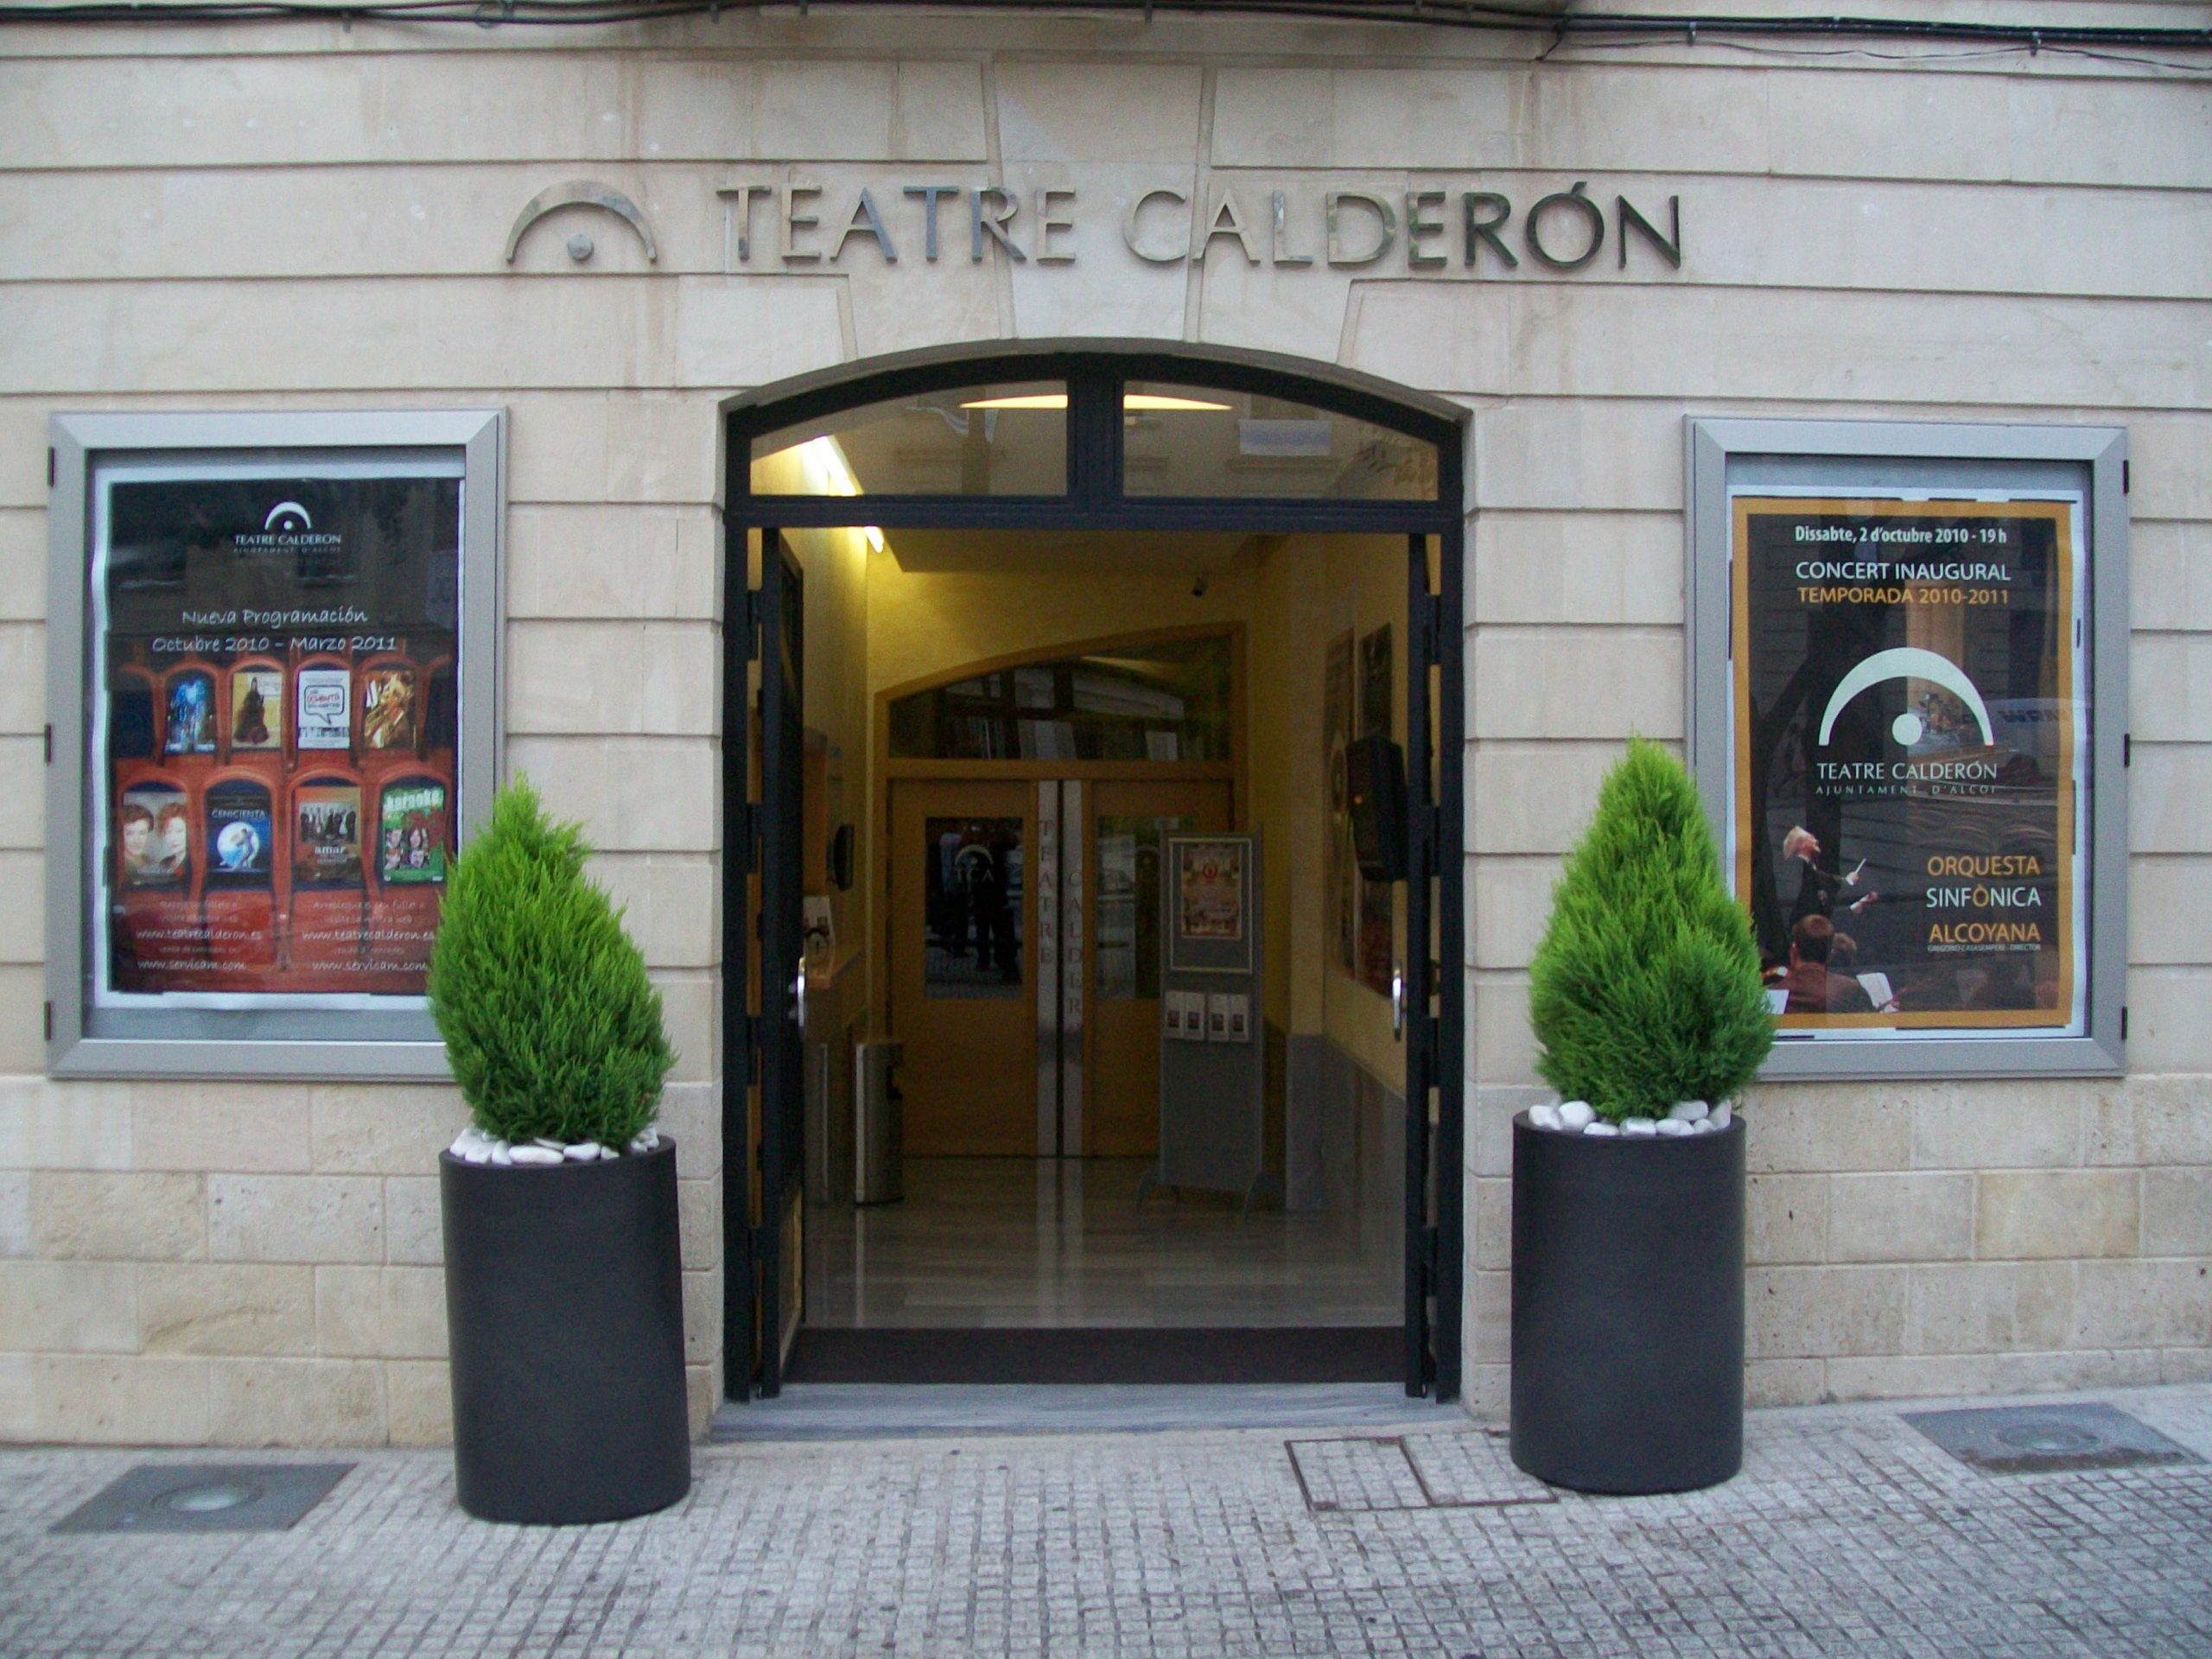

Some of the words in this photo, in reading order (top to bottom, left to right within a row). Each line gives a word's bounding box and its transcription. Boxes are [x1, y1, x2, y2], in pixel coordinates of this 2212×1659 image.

[715, 184, 1076, 263] TEATRE
[1123, 181, 1681, 269] CALDERÓN
[234, 533, 275, 545] TEATRE
[1795, 525, 1857, 543] Dissabte,
[1859, 527, 1868, 542] 2
[1936, 528, 1968, 543] 2010
[1980, 529, 1996, 543] 19
[1998, 529, 2006, 543] h
[1796, 562, 1890, 580] CONCERT
[1895, 563, 2012, 581] INAUGURAL
[1797, 587, 1916, 604] TEMPORADA
[1919, 588, 2009, 605] 2010-2011
[181, 609, 236, 624] Nueva
[242, 606, 368, 629] Programación
[152, 636, 219, 652] Octubre
[225, 637, 270, 651] 2010
[289, 637, 346, 651] Marzo
[351, 636, 397, 651] 2011
[1816, 762, 1885, 779] TEATRE
[1891, 760, 1998, 779] CALDERÓN
[212, 808, 266, 818] CENICIENTA
[1927, 855, 2040, 878] ORQUESTA
[1929, 923, 2041, 943] ALCOYANA
